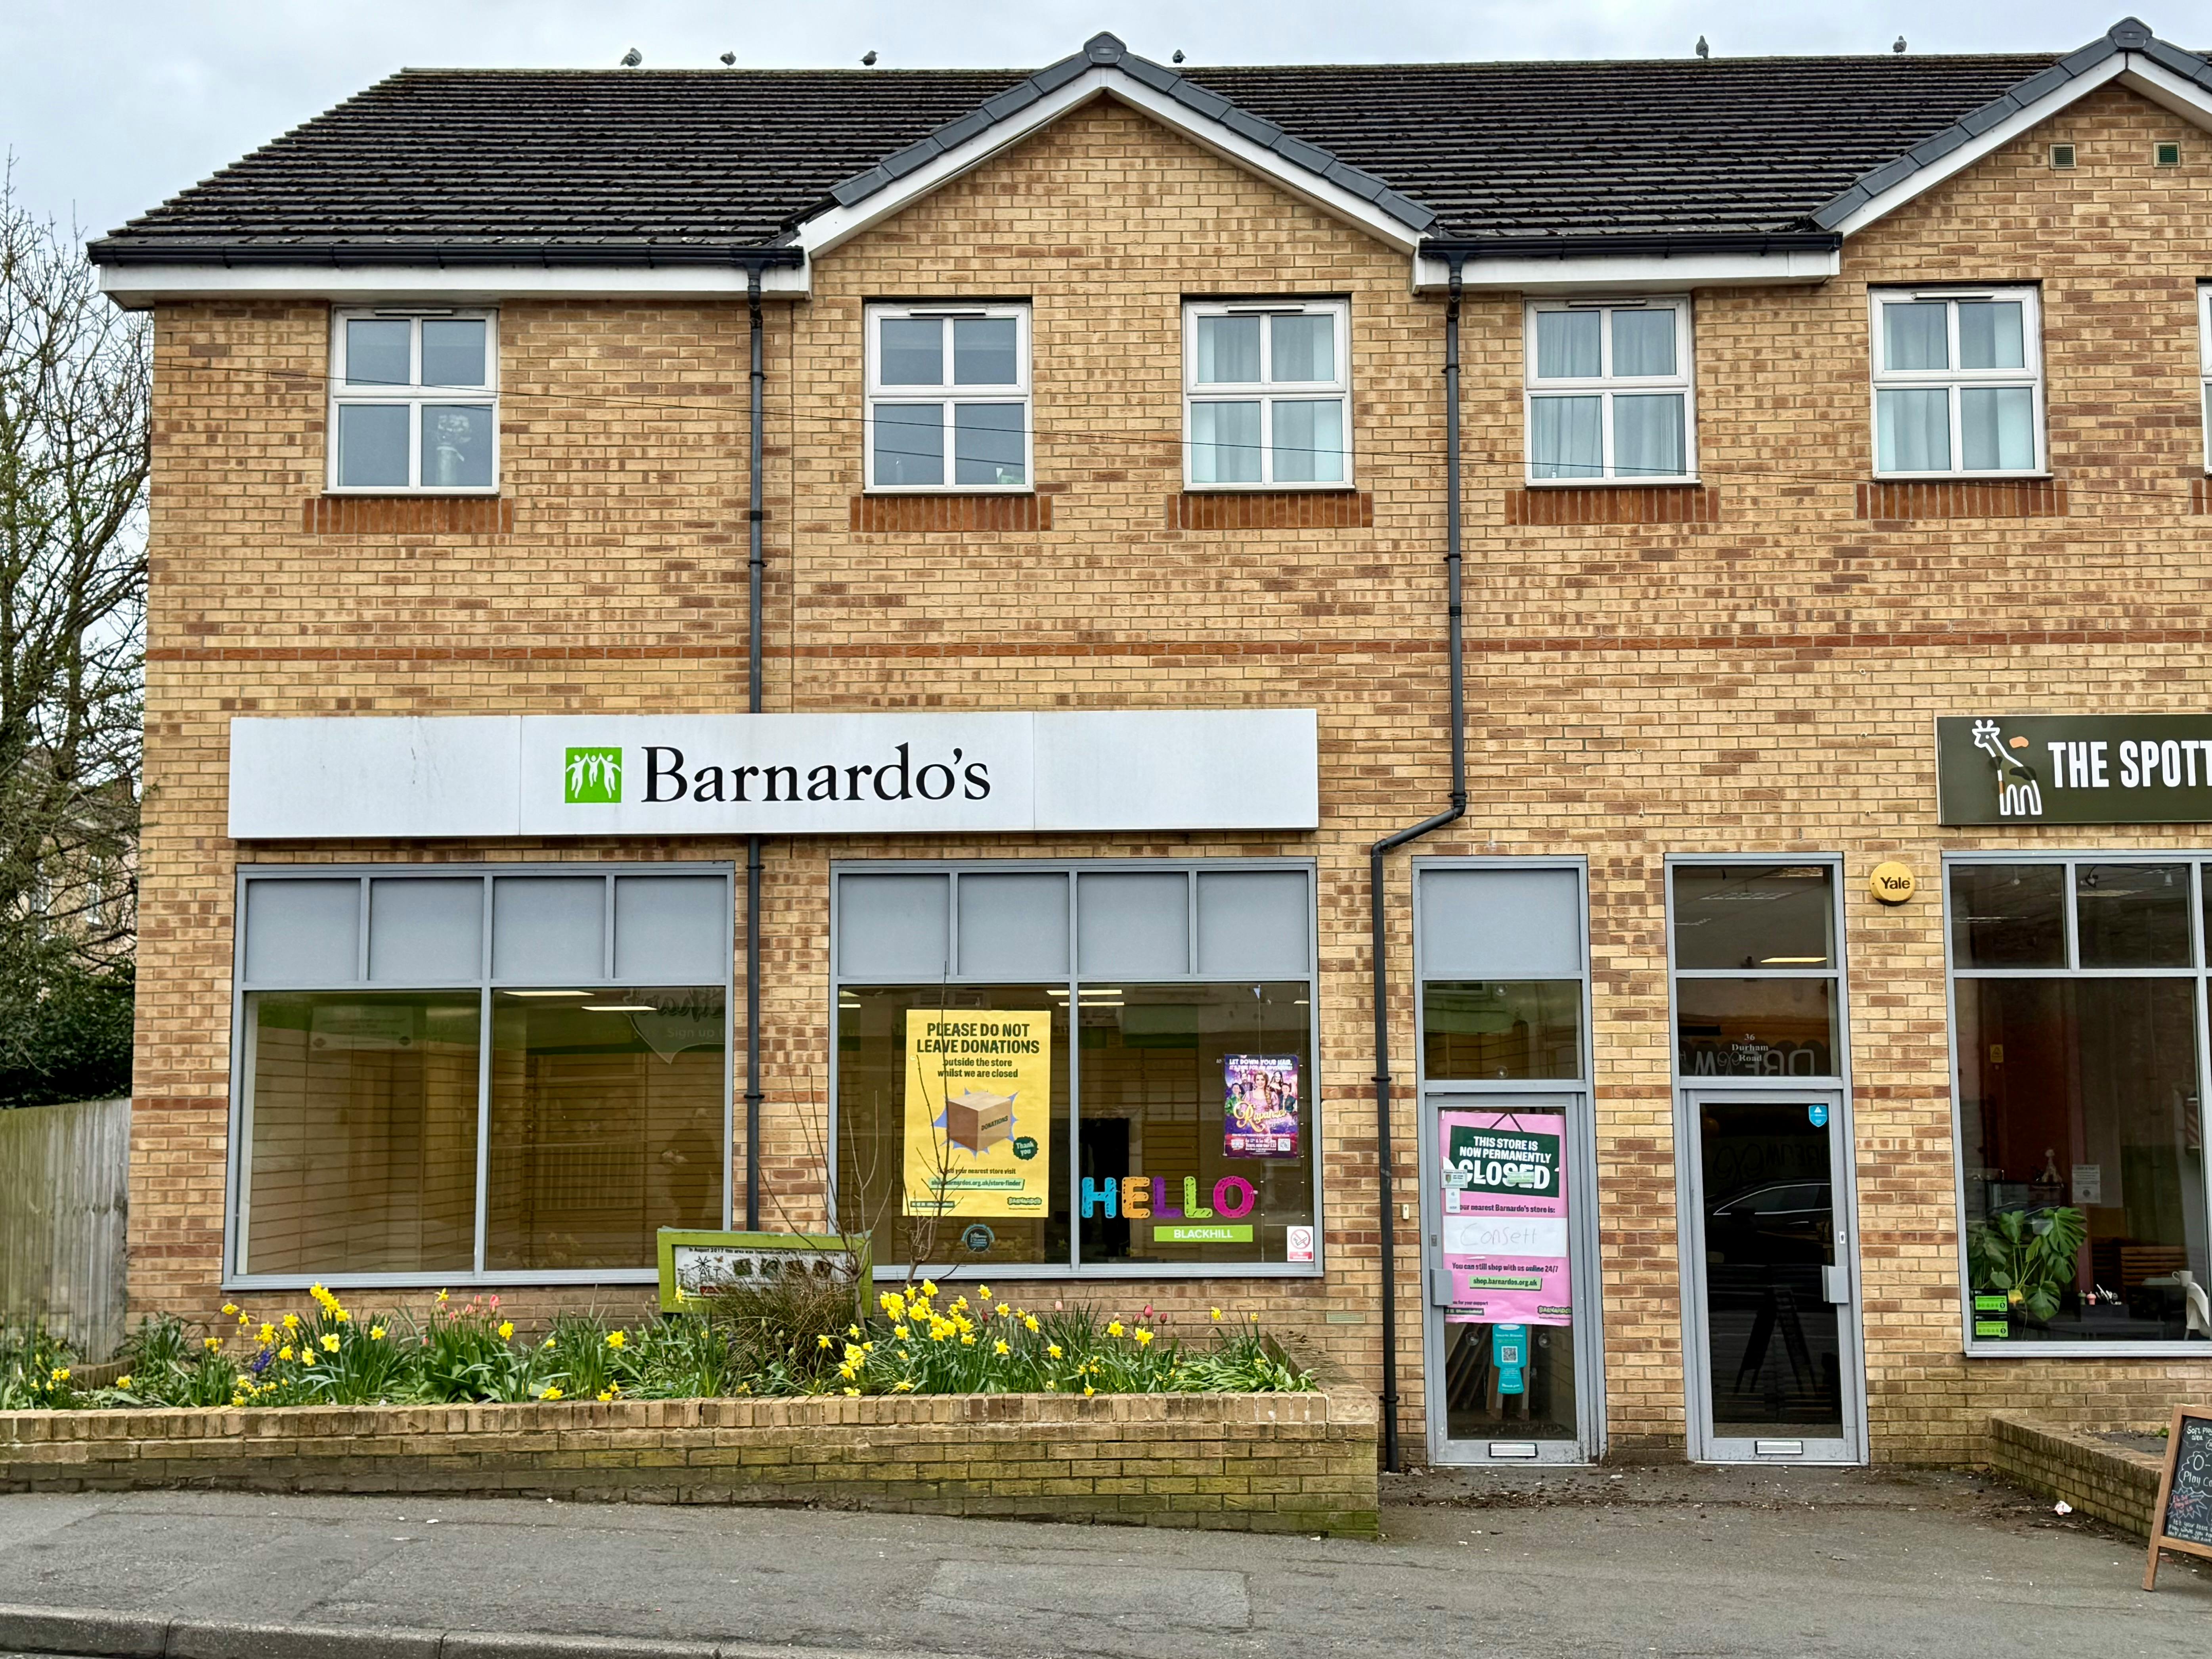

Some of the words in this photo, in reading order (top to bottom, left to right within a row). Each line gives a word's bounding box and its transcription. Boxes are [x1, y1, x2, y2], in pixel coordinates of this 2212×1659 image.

[2048, 741, 2109, 787] THE
[2120, 740, 2212, 787] SPOTT
[641, 742, 991, 803] Barnardo's
[1880, 877, 1910, 889] Yale
[927, 1023, 978, 1036] PLEASE
[980, 1023, 999, 1036] DO
[1003, 1023, 1030, 1036] NOT
[917, 1039, 958, 1052] LEAVE
[961, 1040, 1040, 1054] DONATIONS
[944, 1057, 974, 1066] outside
[976, 1057, 989, 1066] the
[938, 1068, 962, 1077] whilst
[991, 1069, 1018, 1077] closed
[981, 1116, 1008, 1130] DONATIONS
[1016, 1141, 1034, 1149] Thank
[1473, 1136, 1495, 1147] THIS
[1496, 1138, 1527, 1150] STORE
[1529, 1141, 1538, 1151] IS
[1460, 1146, 1481, 1157] NOW
[1483, 1149, 1552, 1163] PERMANENTLY
[1458, 1159, 1550, 1190] CLOSED
[1081, 1175, 1255, 1218] HELLO
[1174, 1229, 1233, 1239] BLACKHILL
[1460, 1223, 1538, 1246] Consett
[1488, 1264, 1502, 1272] shop
[2187, 1426, 2201, 1435] Soft
[2183, 1471, 2201, 1488] Play
